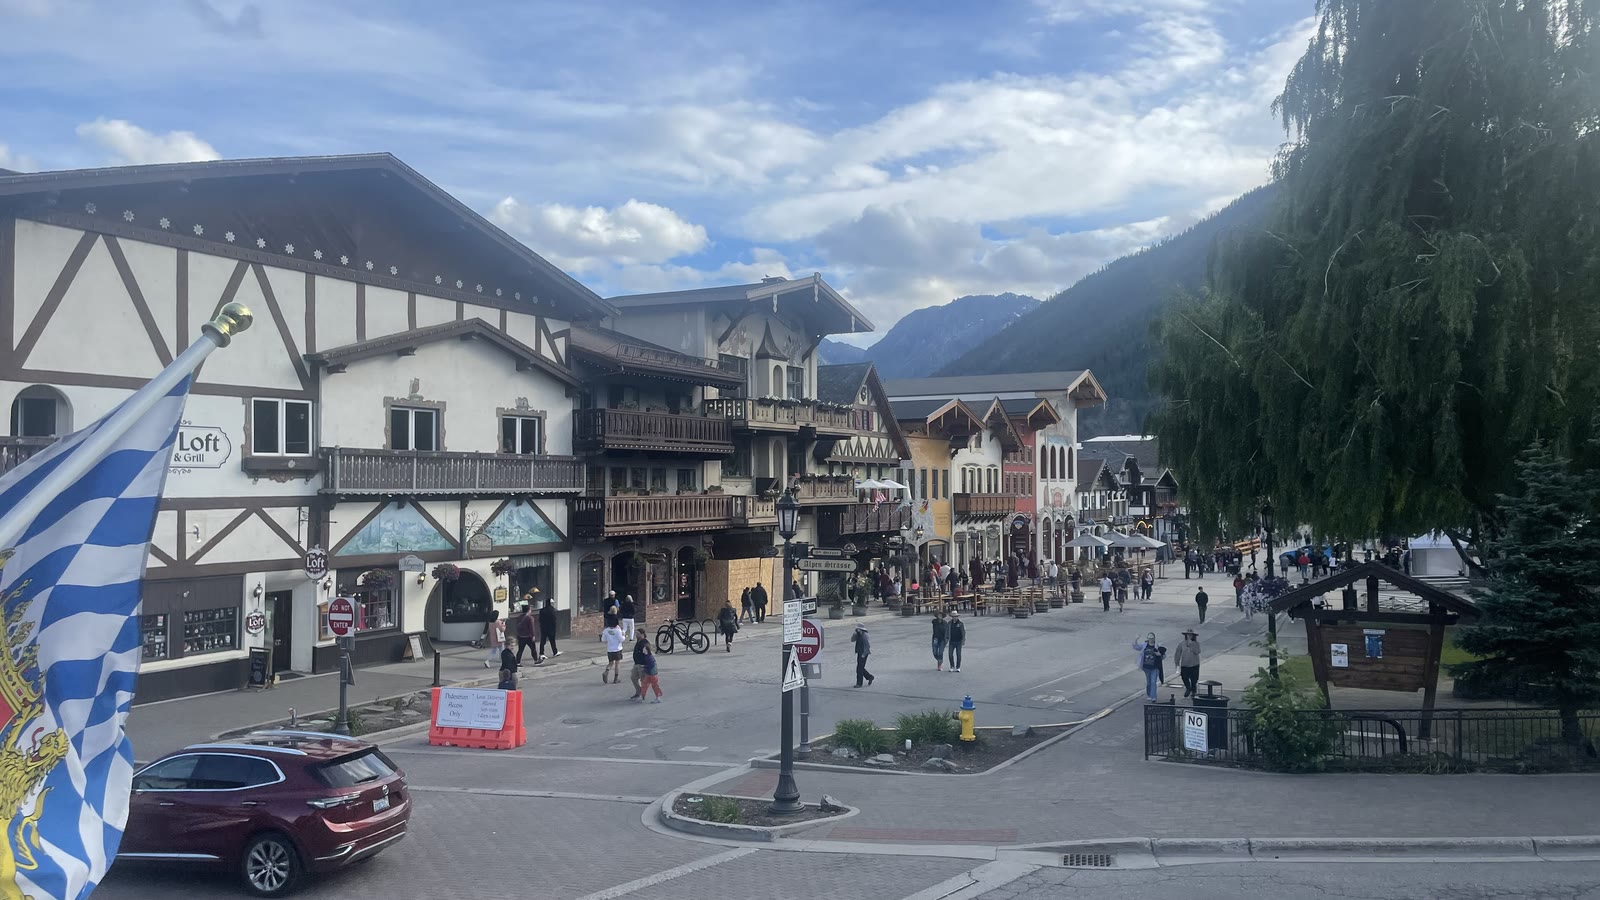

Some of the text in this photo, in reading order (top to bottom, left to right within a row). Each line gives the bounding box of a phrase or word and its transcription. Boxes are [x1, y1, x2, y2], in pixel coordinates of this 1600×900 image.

[179, 431, 220, 452] Loft
[173, 453, 205, 462] & Grill
[306, 556, 325, 568] Loft
[803, 560, 851, 569] Alpen Strasse
[249, 617, 264, 627] Loft
[333, 621, 349, 629] ENTER
[796, 646, 813, 654] NTER
[1188, 715, 1203, 727] NO
